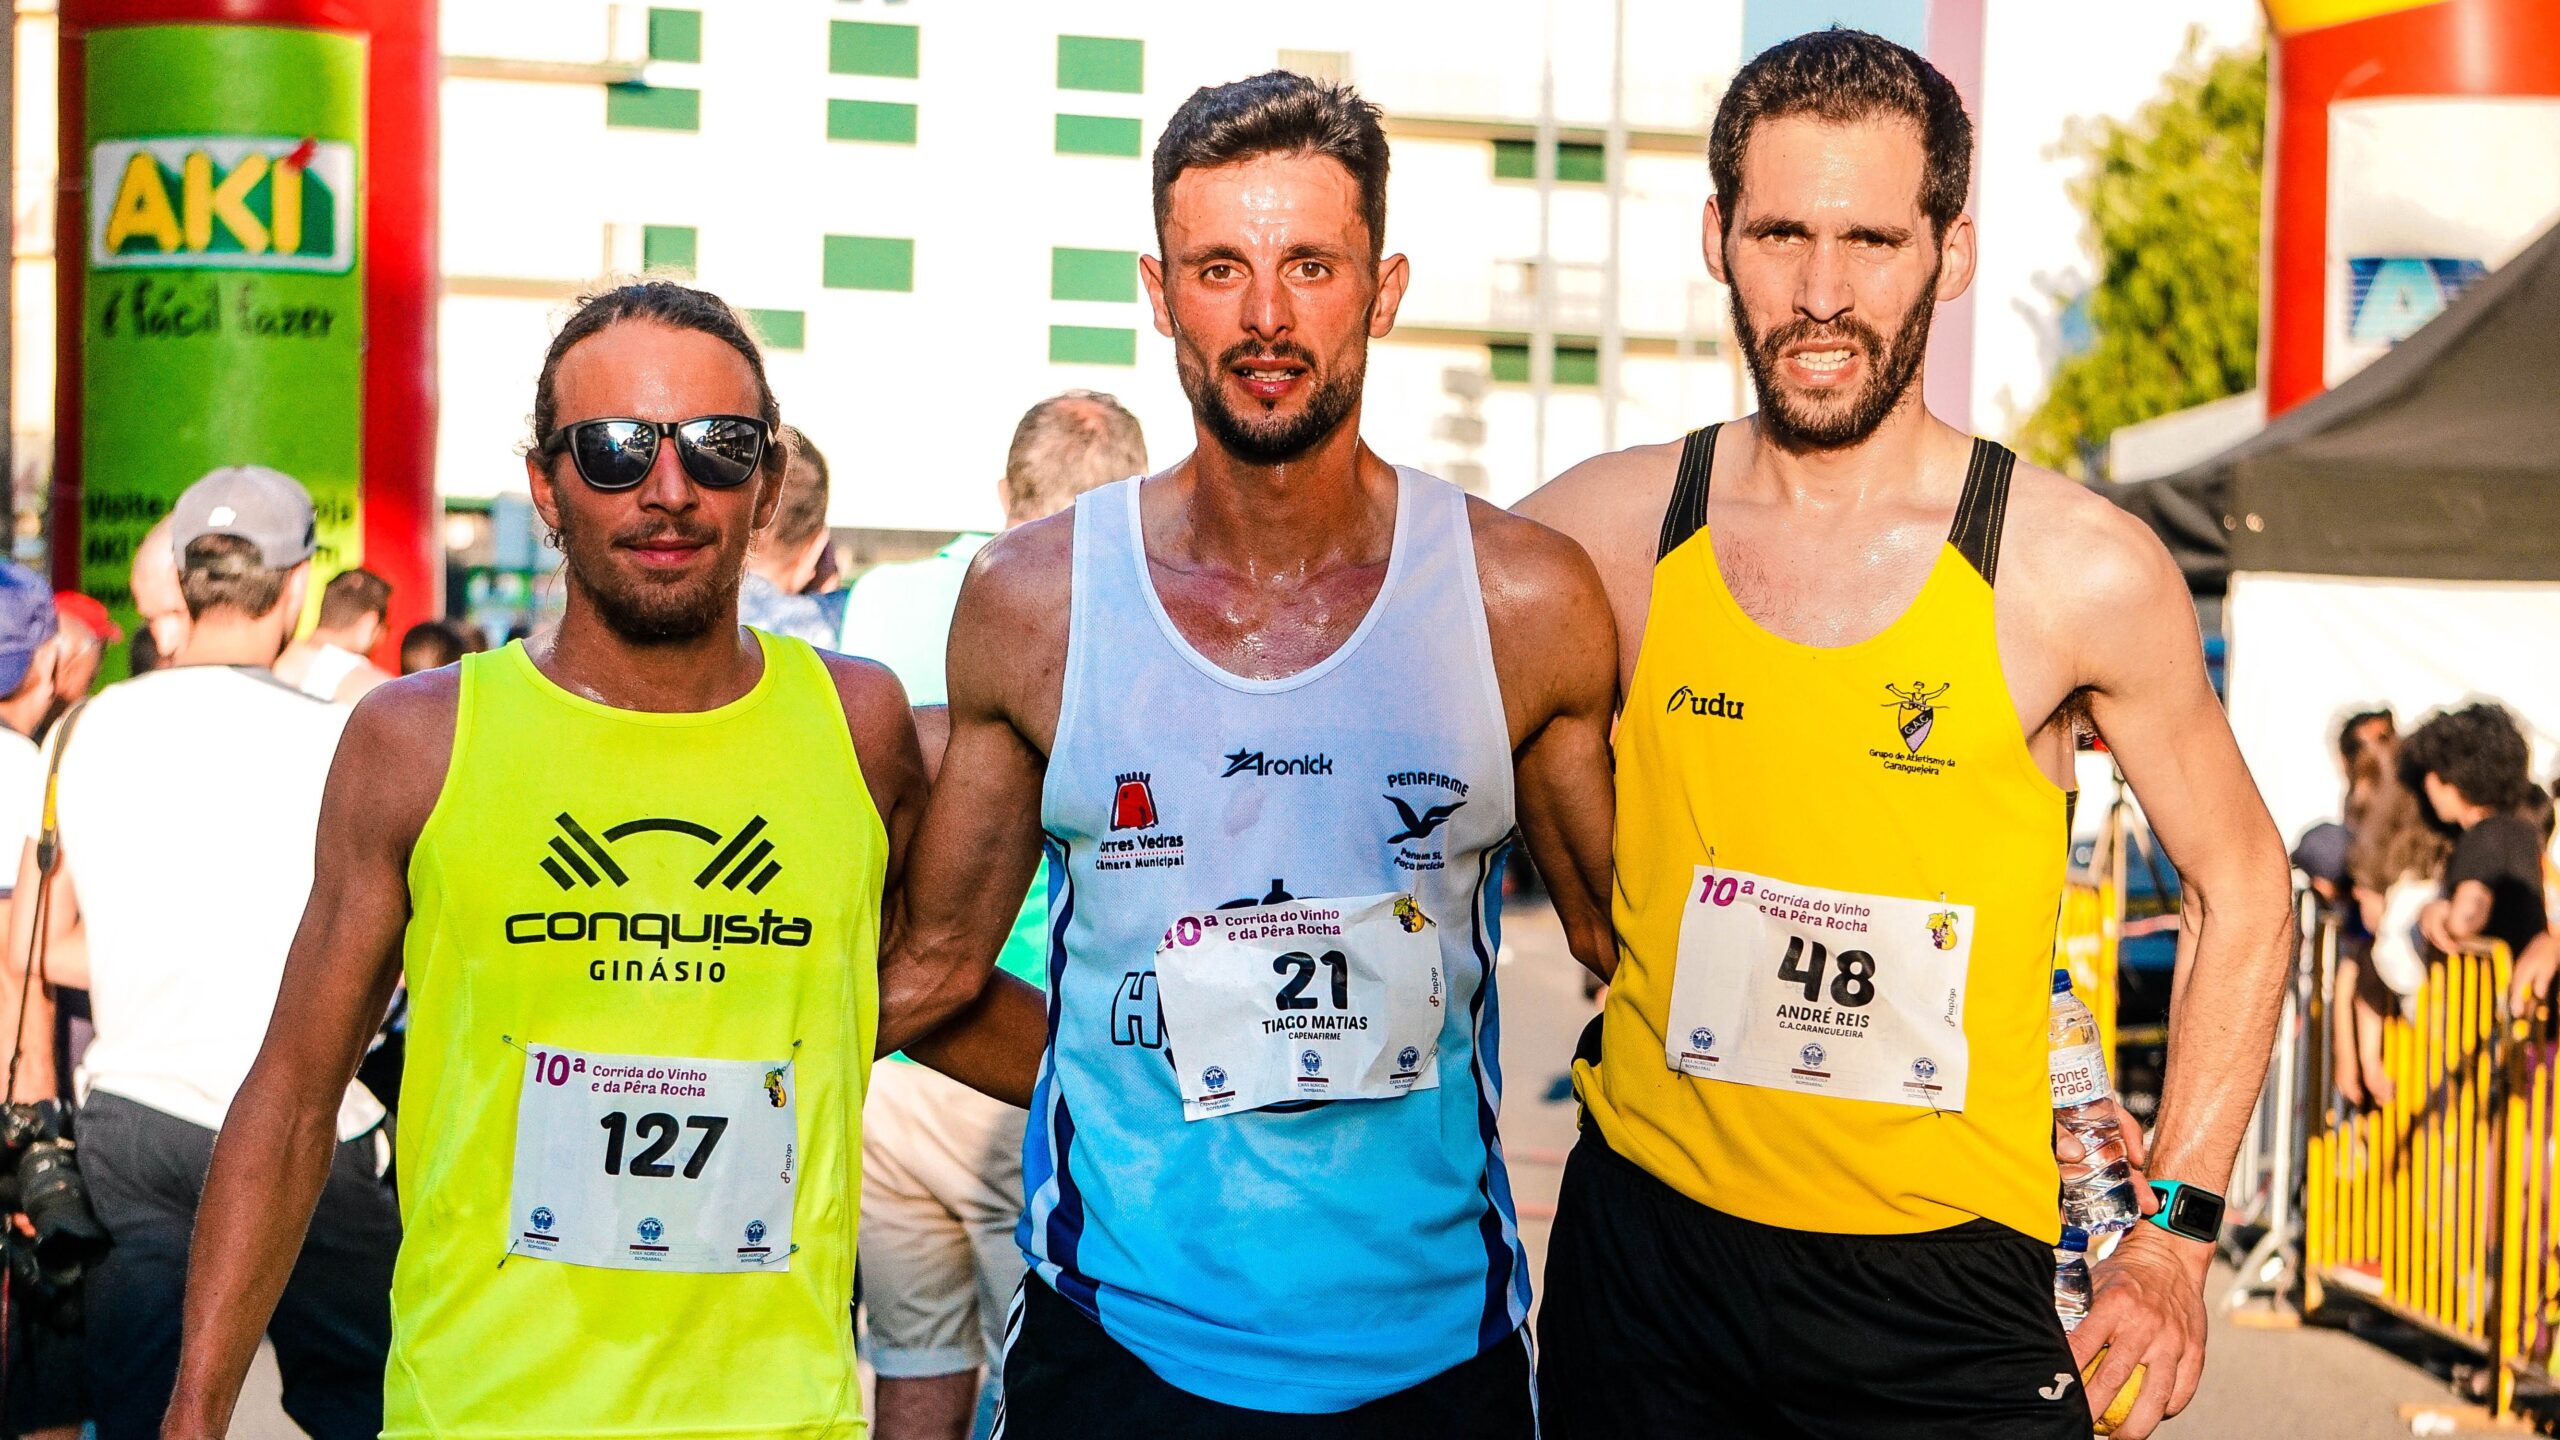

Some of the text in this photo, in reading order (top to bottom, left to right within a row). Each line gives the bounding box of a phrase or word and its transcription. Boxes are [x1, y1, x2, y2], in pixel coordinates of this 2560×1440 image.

[130, 277, 221, 339] fácil
[237, 280, 336, 338] fazer
[1222, 750, 1333, 777] Aronick
[1869, 749, 1956, 767] Grupo de Atletismo da
[1883, 761, 1940, 775] Caranguejeira
[1387, 772, 1469, 797] PENAFIRME
[1137, 833, 1184, 850] Vedras
[1135, 855, 1185, 868] Municipal
[1760, 888, 1810, 910] Corrida
[1812, 898, 1830, 913] do
[1833, 902, 1871, 917] Vinho
[505, 908, 813, 951] conquista
[1225, 912, 1278, 926] Corrida
[1280, 910, 1298, 922] do
[1300, 909, 1340, 921] Vinho
[1759, 905, 1868, 933] e da Pêra Rocha
[1228, 923, 1341, 941] e da Pêra Rocha
[589, 957, 726, 983] GINÁSIO
[1272, 950, 1349, 1011] 21
[1431, 967, 1440, 995] lap2go
[1777, 935, 1876, 1008] 48
[1261, 1015, 1368, 1035] TIAGO MATIAS
[1776, 1003, 1870, 1029] ANDRÉ REIS
[1288, 1031, 1341, 1042] CAPENAFIRME
[1779, 1020, 1863, 1039] G.A.CARANGUEJEIRA
[592, 1065, 645, 1080] Corrida
[646, 1066, 665, 1080] do
[667, 1068, 707, 1082] Vinho
[591, 1079, 706, 1097] e da Pêra Rocha
[600, 1111, 729, 1179] 127
[784, 1143, 792, 1171] lap2go
